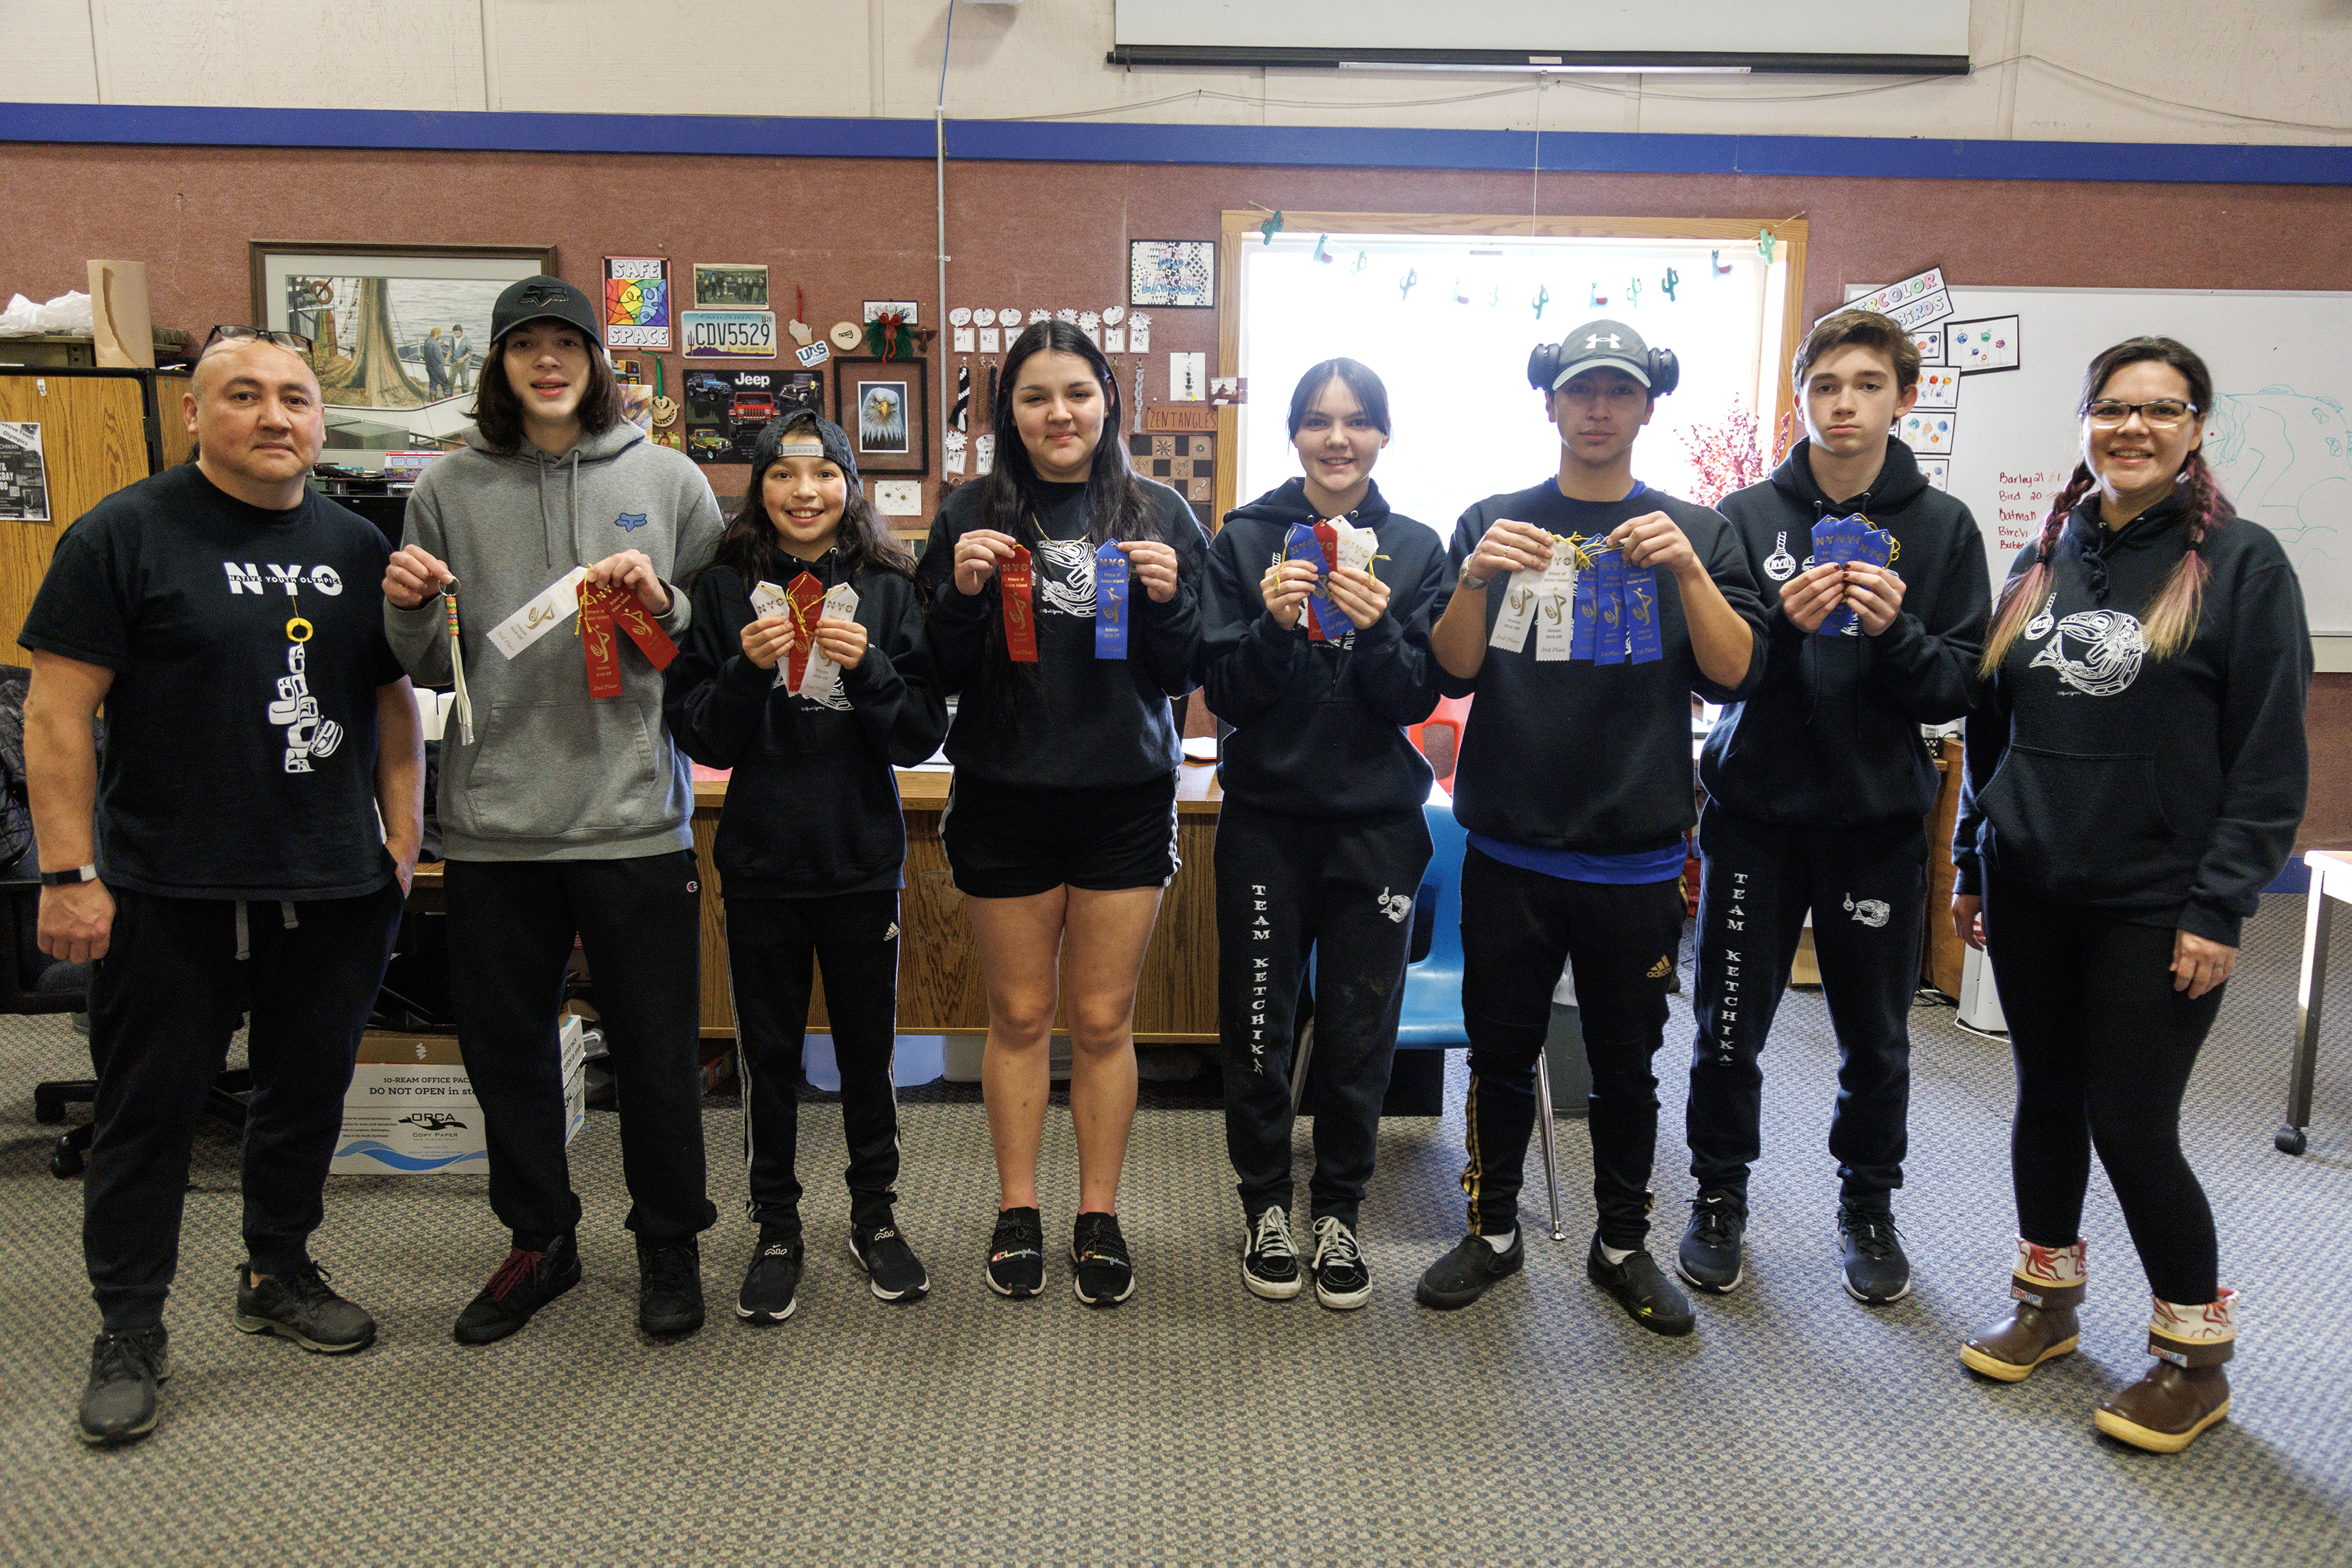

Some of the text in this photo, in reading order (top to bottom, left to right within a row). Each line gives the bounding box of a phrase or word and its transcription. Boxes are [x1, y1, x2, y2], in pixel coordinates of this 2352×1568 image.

[1158, 247, 1189, 270] MS.
[614, 261, 659, 278] SAFE
[1142, 274, 1201, 295] LASSE
[1854, 274, 1936, 311] ERCOLOR
[609, 327, 668, 344] SPACE
[695, 323, 770, 346] CDV5529
[956, 335, 966, 344] #1
[1108, 334, 1118, 344] #7
[1134, 335, 1144, 346] #8
[798, 343, 827, 361] UAS
[735, 372, 770, 387] Jeep
[1150, 411, 1217, 428] ZENTANGLES
[3, 430, 28, 445] Olympics
[19, 430, 35, 440] Youth
[949, 454, 961, 467] #9
[2000, 472, 2032, 488] Barley
[1999, 490, 2042, 502] Bird 20
[1999, 507, 2036, 521] Batman
[1998, 526, 2028, 537] Birch
[1816, 536, 1834, 546] NY
[1858, 543, 1885, 562] NYO
[1003, 563, 1028, 572] NYO
[1100, 558, 1125, 567] NYO
[224, 562, 344, 596] NYO
[596, 584, 612, 602] NY
[757, 597, 785, 614] NYO
[827, 599, 854, 614] NYO
[1727, 873, 1748, 931] TEAM
[1252, 884, 1271, 940] TEAM
[1647, 966, 1672, 977] adidas
[1719, 949, 1742, 1066] KETCHIKA
[448, 1086, 459, 1095] in
[2013, 1288, 2040, 1303] XTRATUF
[2151, 1347, 2184, 1361] XTRATUF
